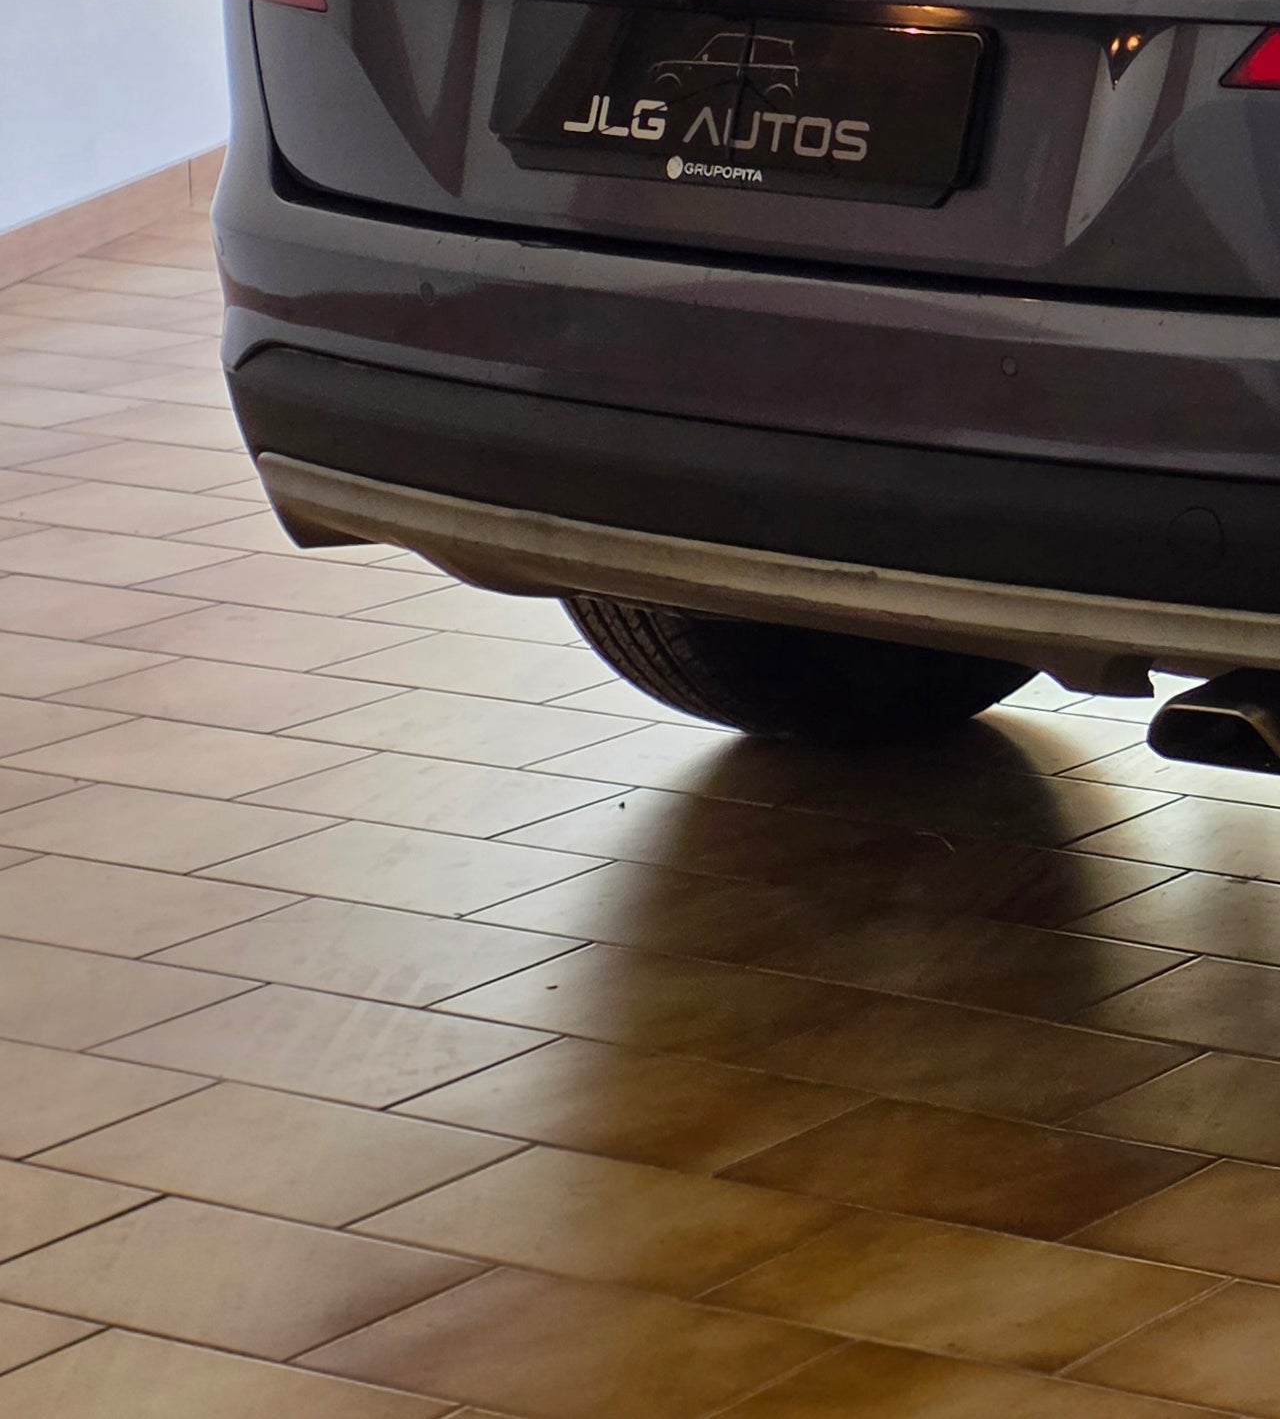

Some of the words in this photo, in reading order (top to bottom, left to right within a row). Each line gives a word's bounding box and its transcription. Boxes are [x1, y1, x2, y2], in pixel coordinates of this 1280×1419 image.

[562, 94, 668, 141] JLG
[682, 106, 870, 162] AUTOS
[683, 160, 764, 184] GRUPOPITA
